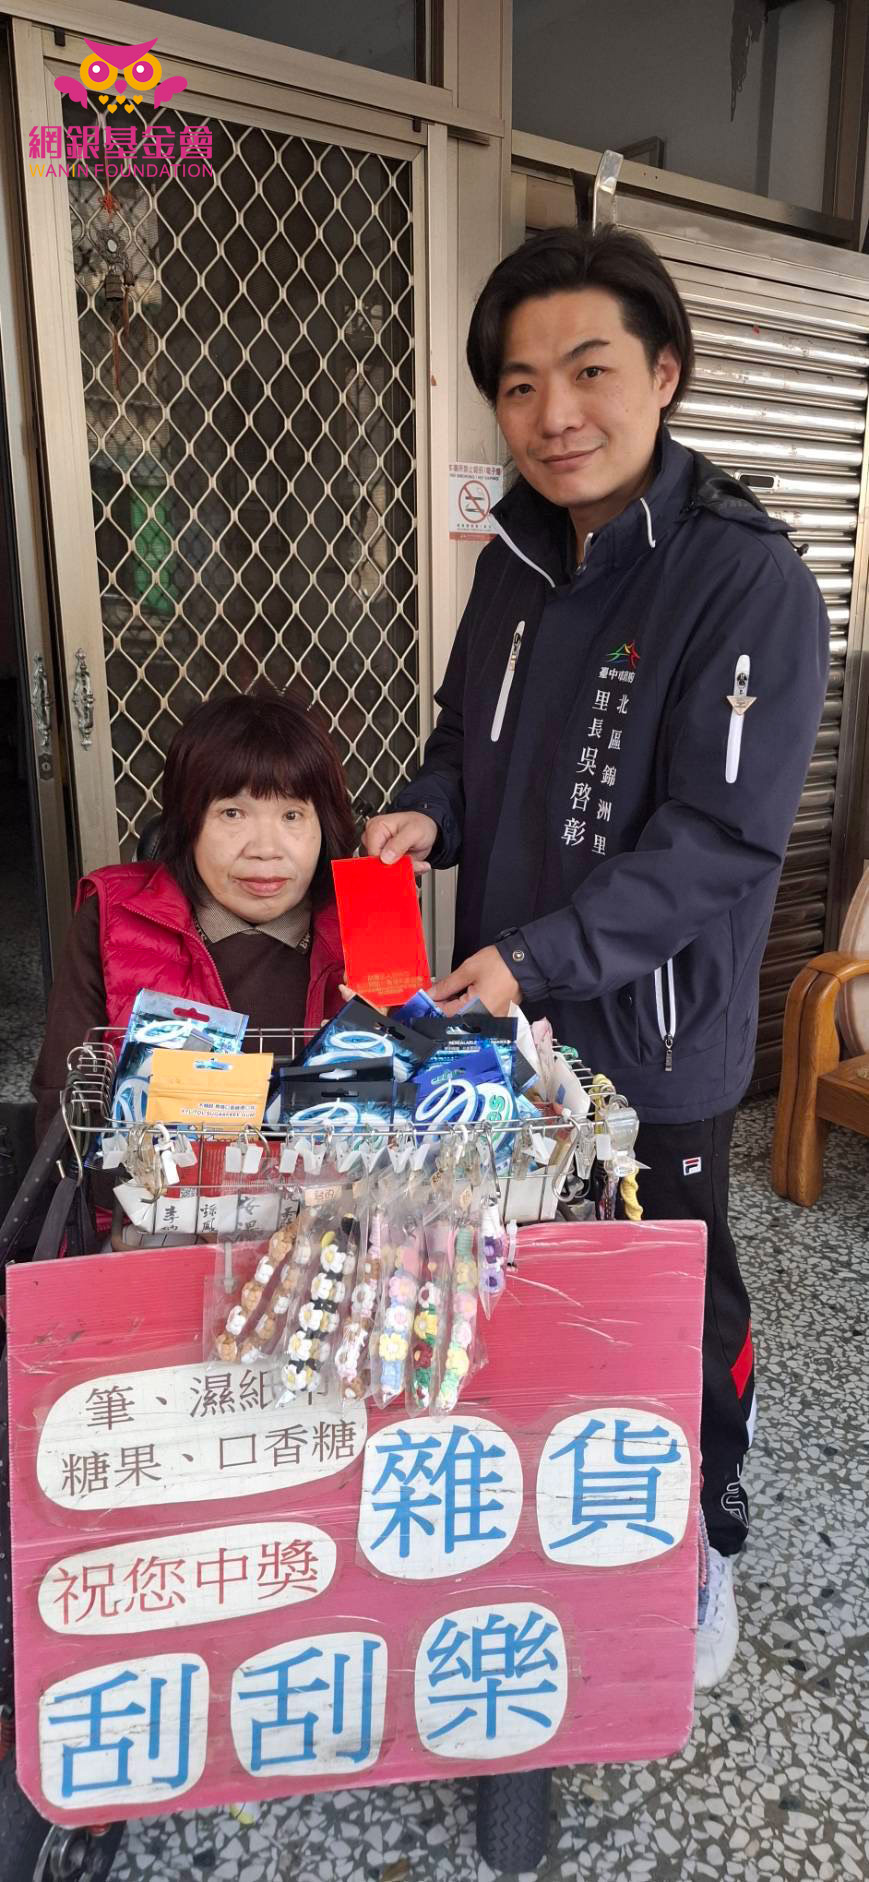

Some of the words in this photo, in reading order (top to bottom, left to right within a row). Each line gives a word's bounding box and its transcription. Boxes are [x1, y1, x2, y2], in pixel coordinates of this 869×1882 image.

[591, 693, 631, 856] 北區錦洲里
[61, 1419, 358, 1498] 糖果、口香糖
[369, 1418, 683, 1559] 雜貨
[52, 1538, 321, 1626] 祝您中獎
[47, 1610, 560, 1800] 刮刮樂
